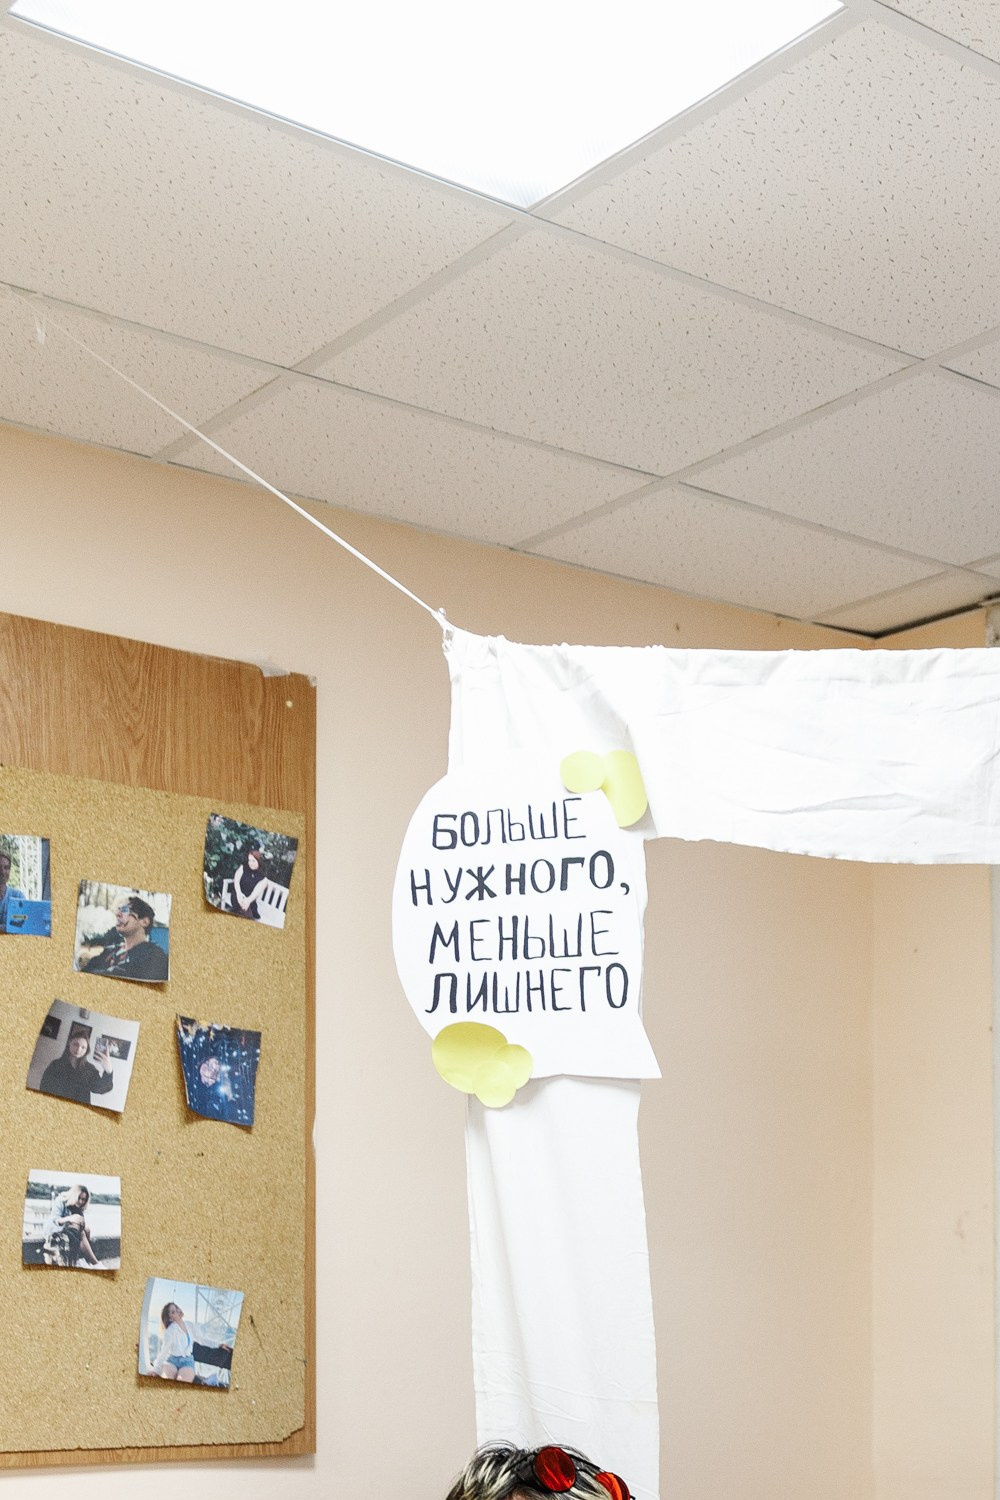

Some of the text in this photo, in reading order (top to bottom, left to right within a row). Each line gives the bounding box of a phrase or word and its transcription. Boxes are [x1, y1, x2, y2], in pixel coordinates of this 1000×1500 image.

[431, 796, 587, 851] БОЛЬШЕ
[409, 849, 631, 907] НУЖНОГО,
[428, 909, 620, 965] МЕНЬШЕ
[424, 961, 630, 1015] ЛИШНЕГО
